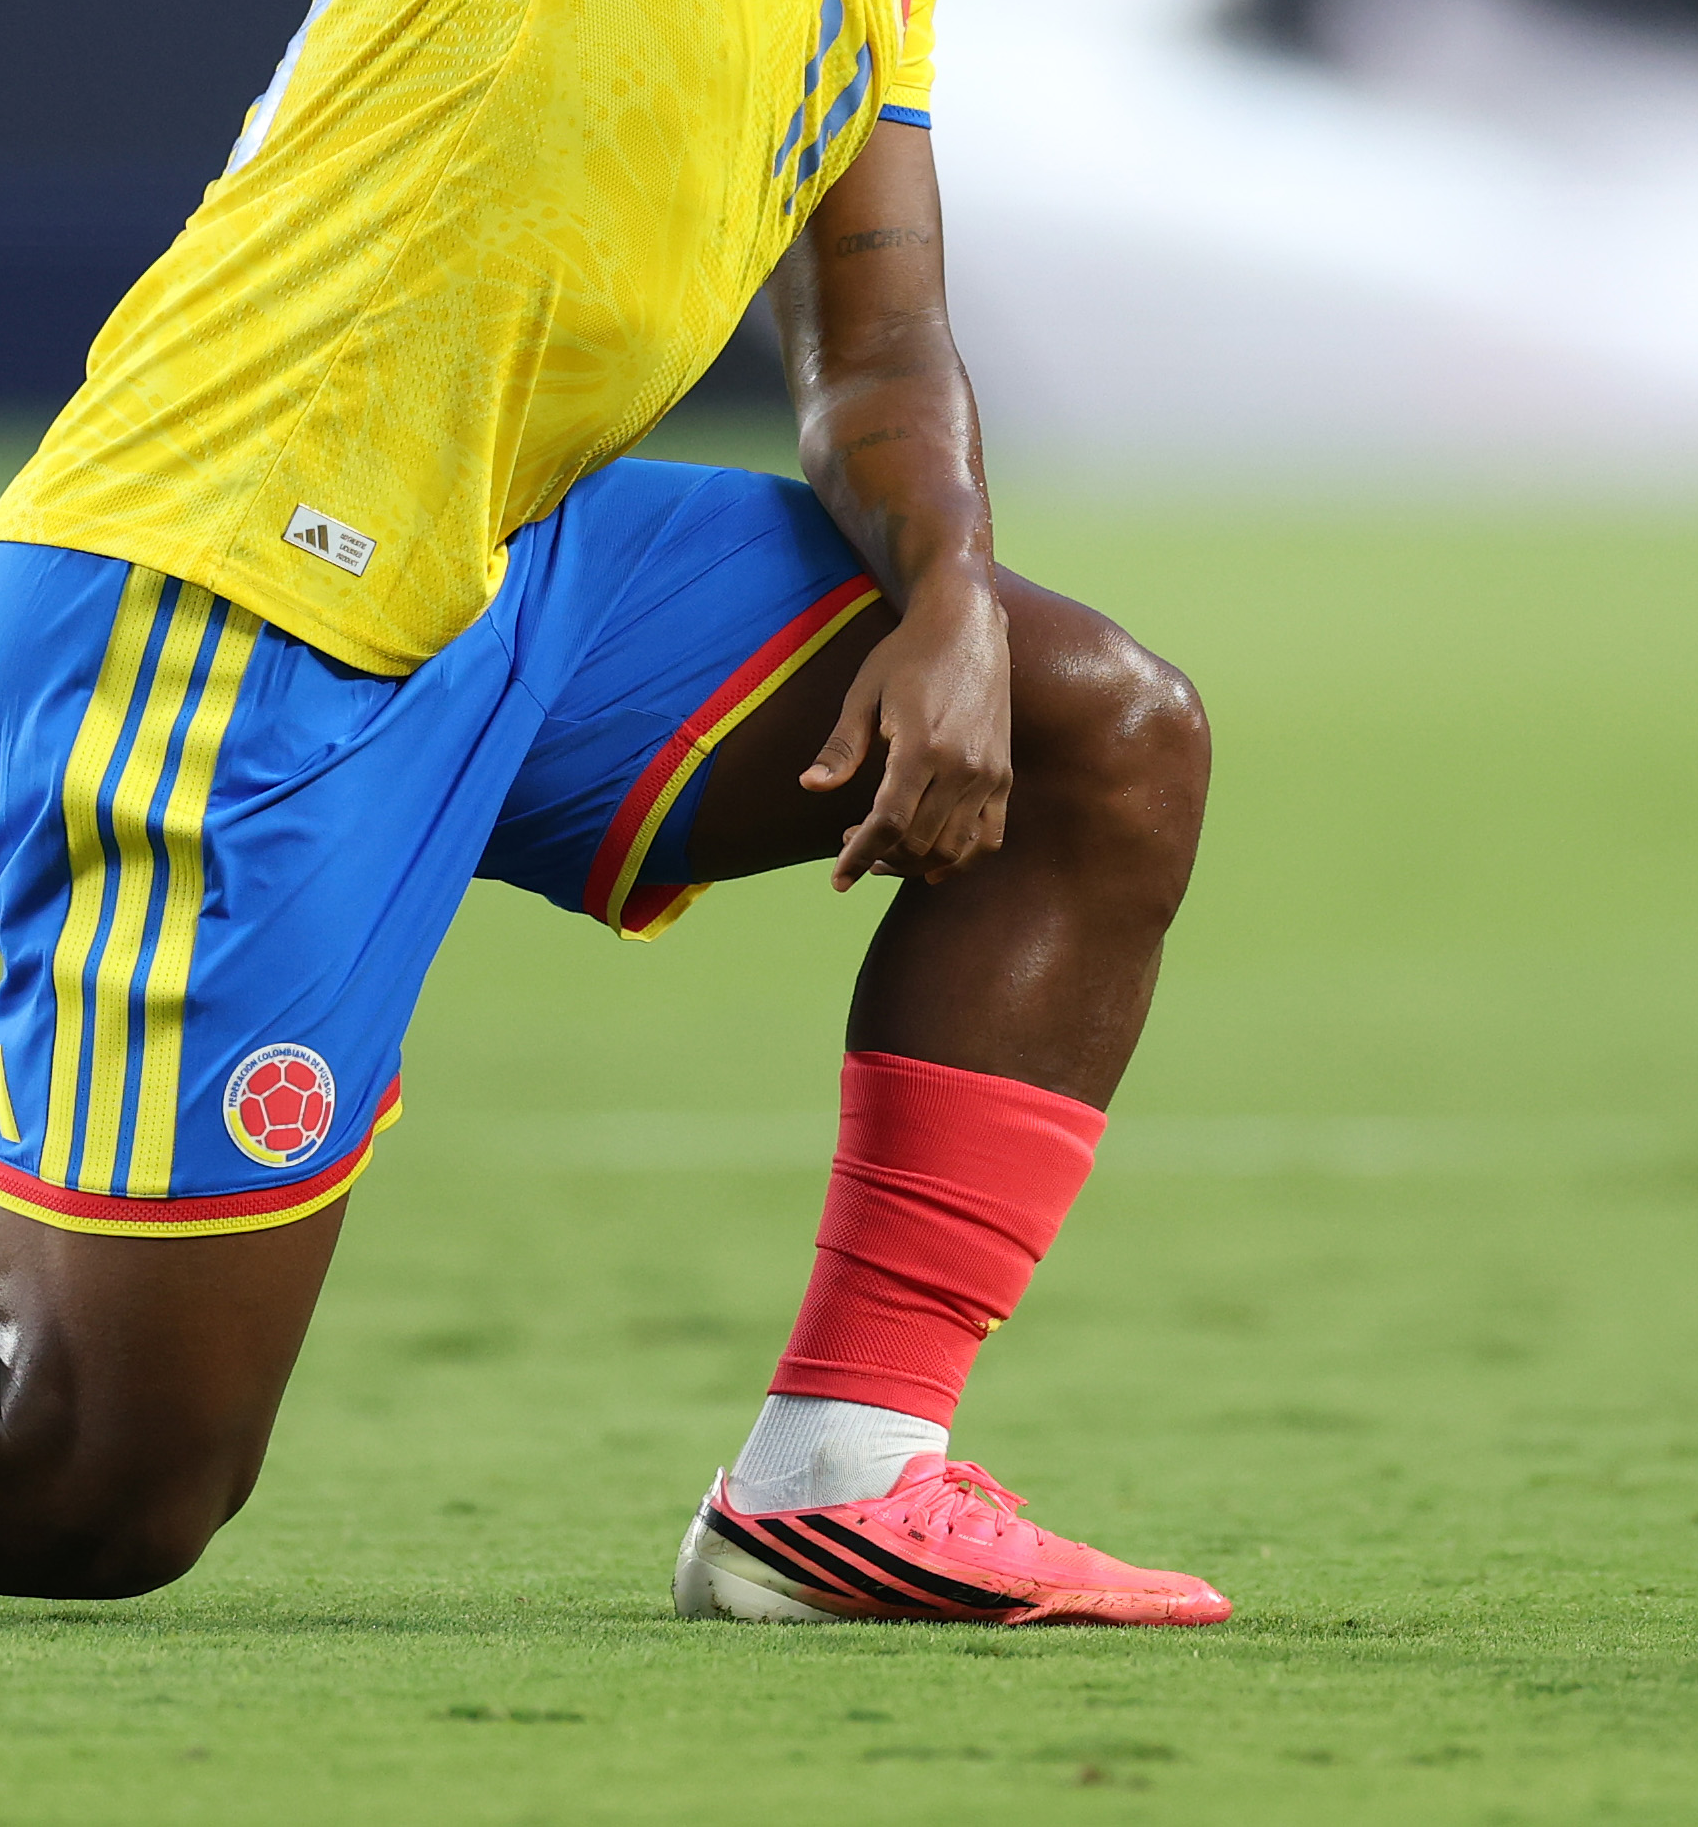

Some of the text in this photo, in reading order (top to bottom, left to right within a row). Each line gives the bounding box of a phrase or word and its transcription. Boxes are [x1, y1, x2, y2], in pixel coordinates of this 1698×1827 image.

[336, 552, 359, 567] PRODUCT
[258, 1048, 311, 1062] COLOMBIANA
[311, 1058, 321, 1070] DE
